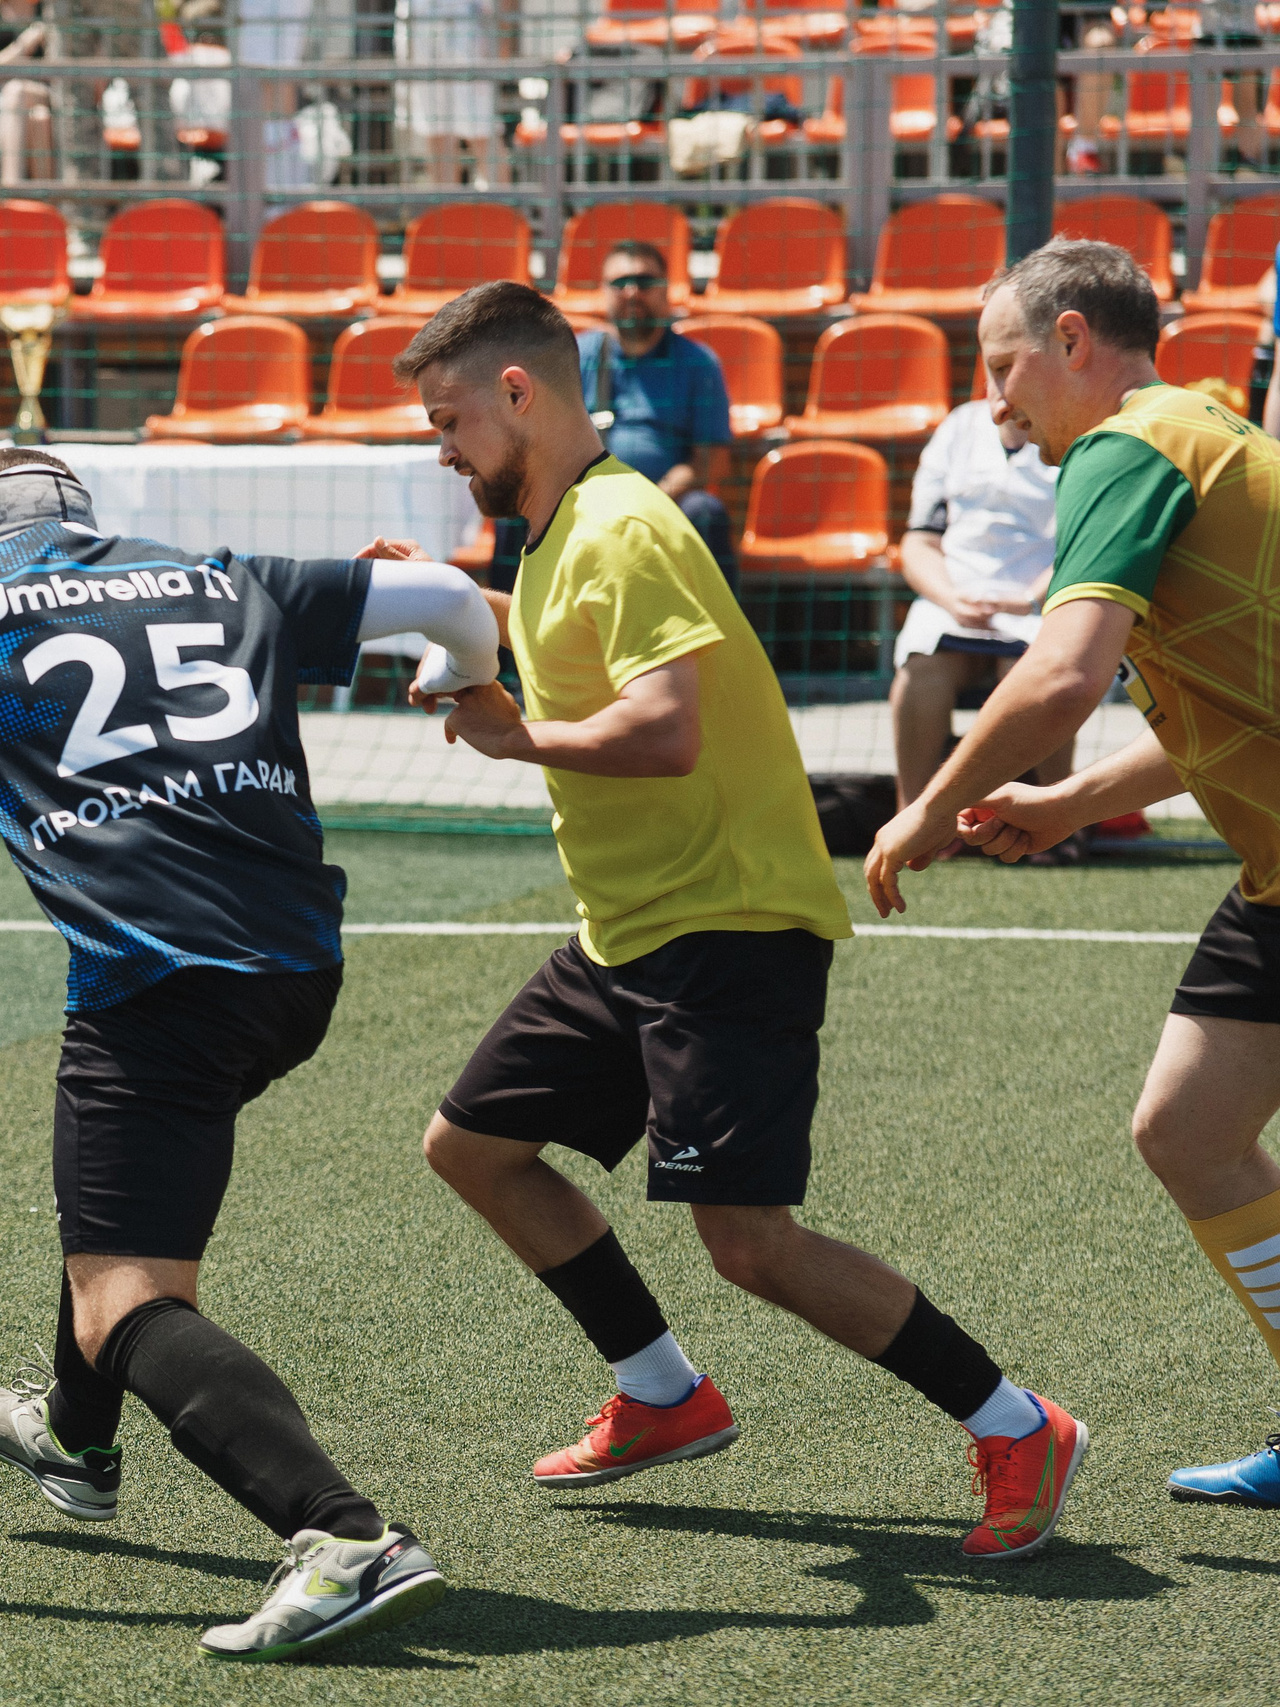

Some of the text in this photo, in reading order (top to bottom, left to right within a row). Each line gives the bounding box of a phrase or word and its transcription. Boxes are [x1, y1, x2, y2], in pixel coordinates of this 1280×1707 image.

[195, 564, 239, 602] IT
[22, 622, 260, 778] 25
[29, 759, 298, 851] ПРОДАМ ГАРАЖ
[654, 1160, 705, 1173] DEMIX
